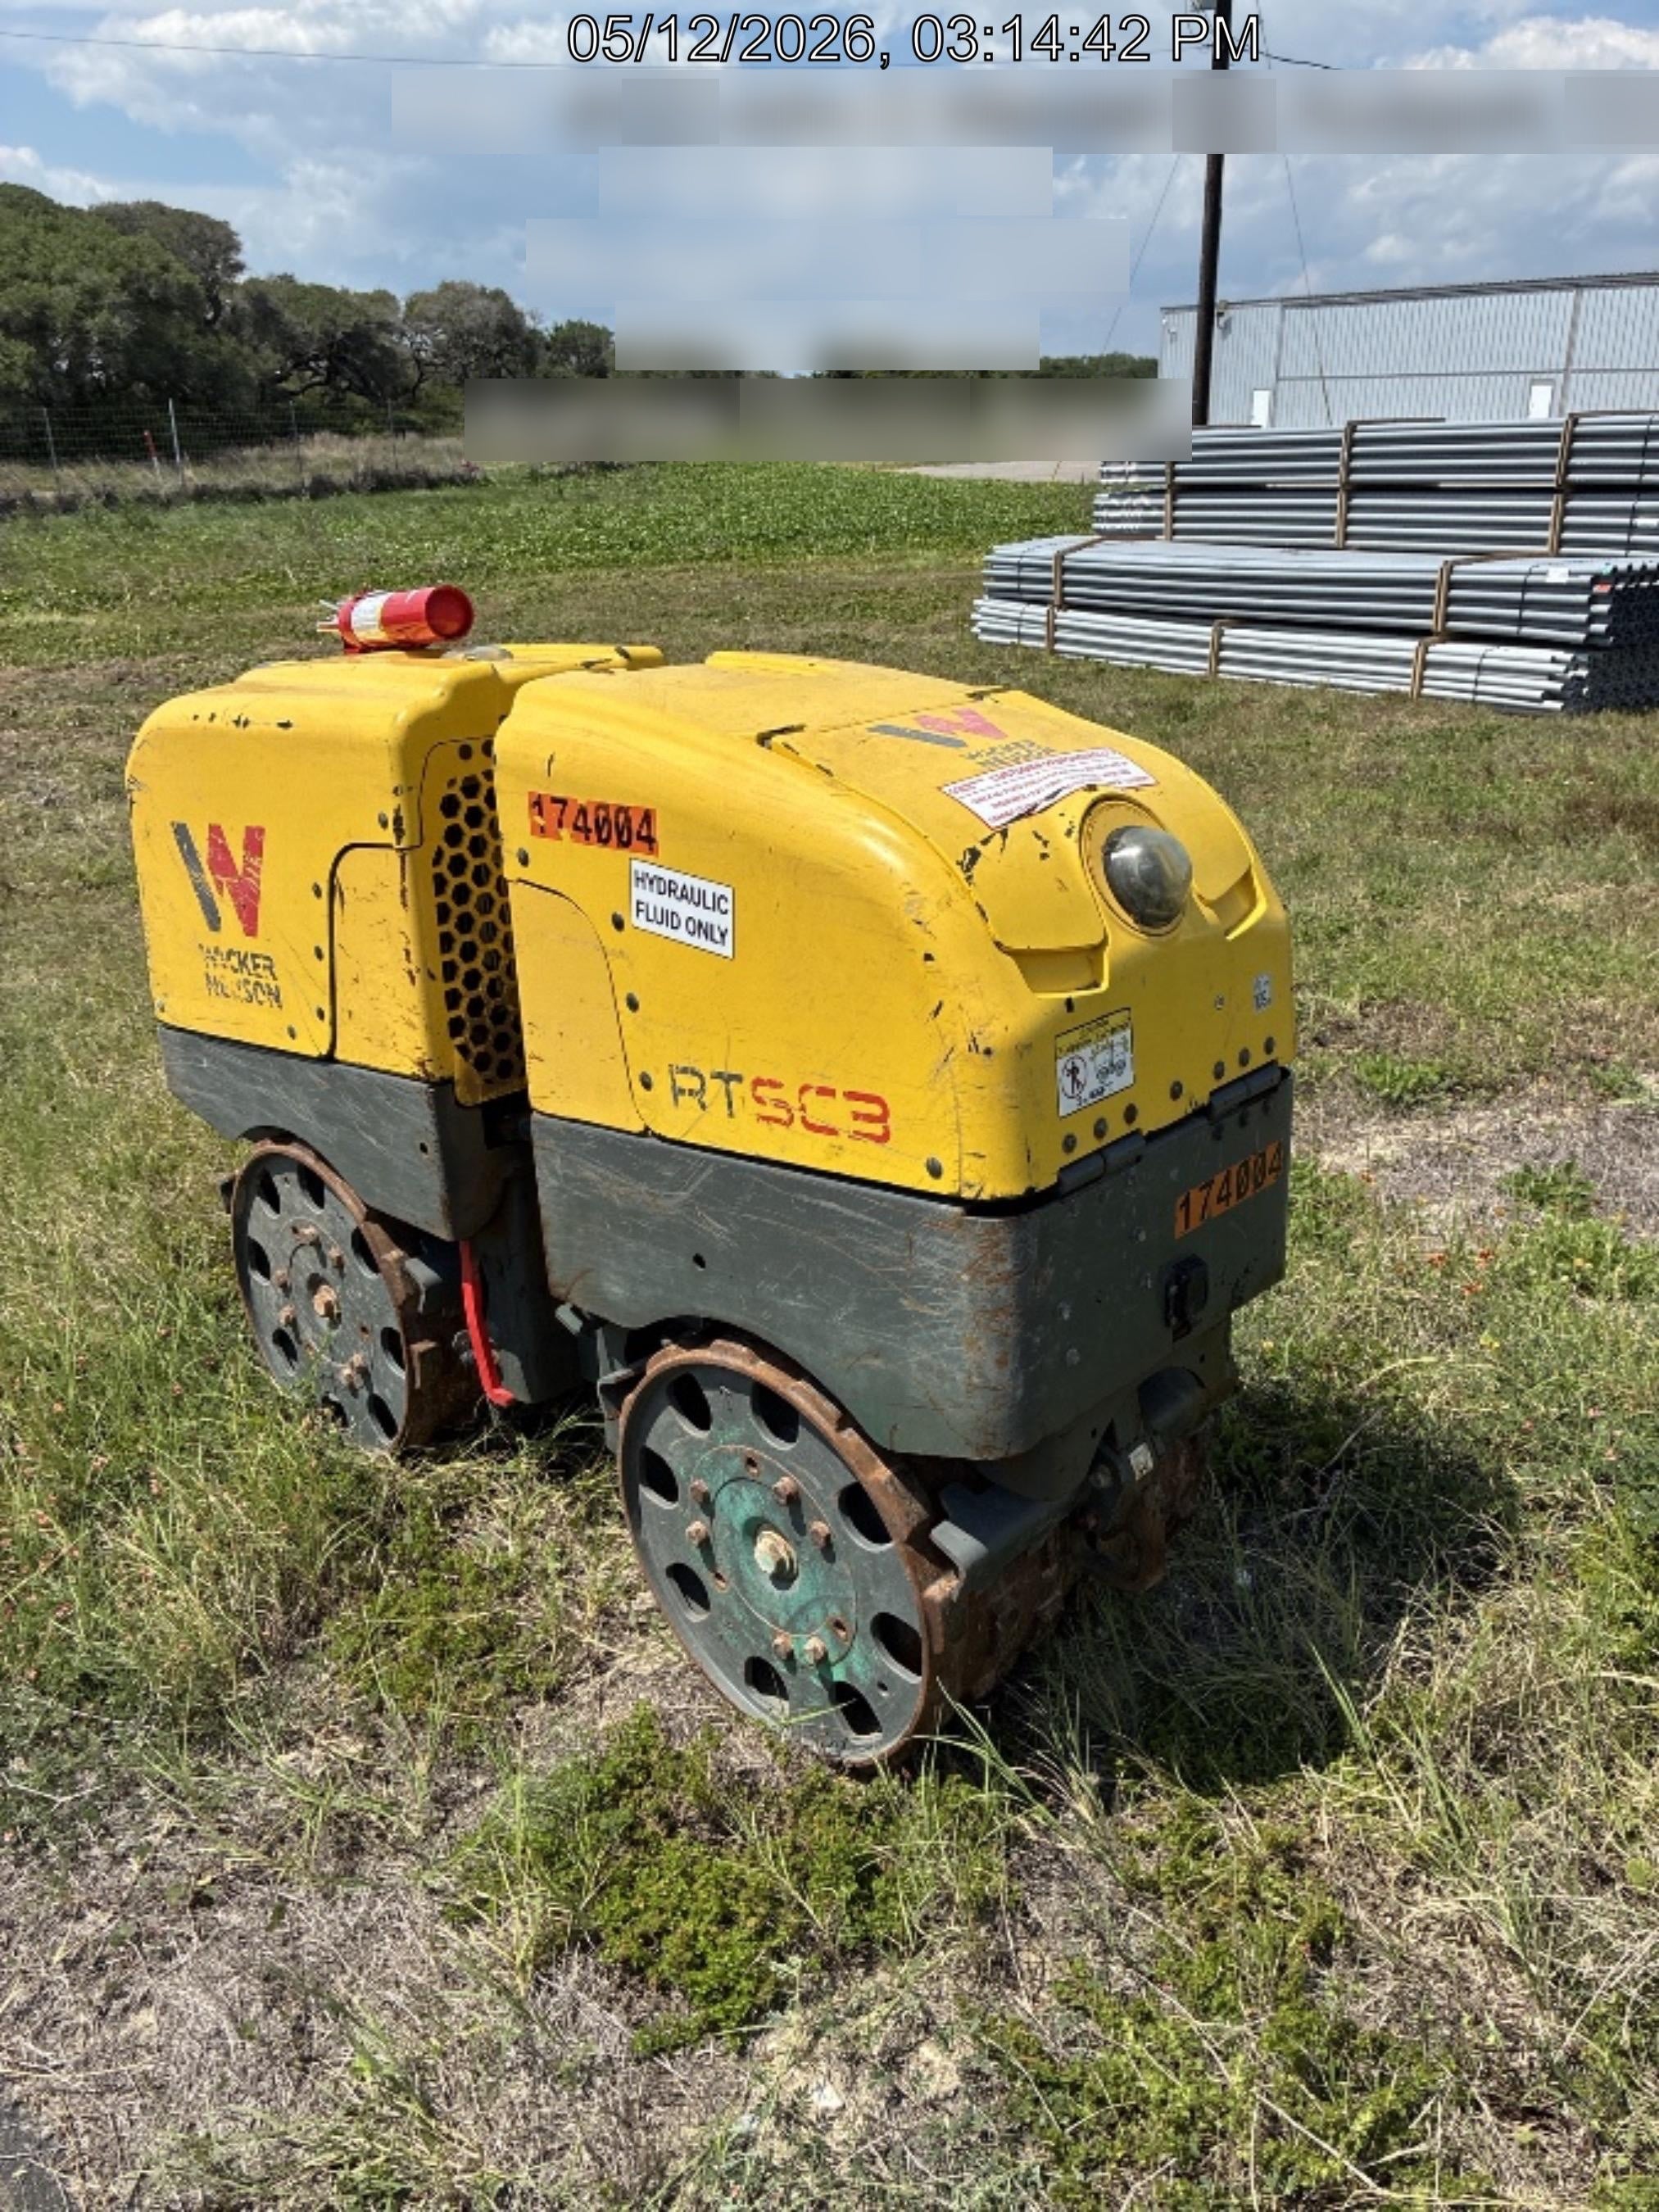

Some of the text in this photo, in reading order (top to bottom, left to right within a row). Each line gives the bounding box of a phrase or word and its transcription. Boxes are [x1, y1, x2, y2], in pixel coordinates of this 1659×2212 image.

[531, 793, 656, 851] 174004
[633, 869, 730, 915] HYDRAULIC
[635, 899, 729, 947] FLUID ONLY
[1179, 1140, 1283, 1232] 174004
